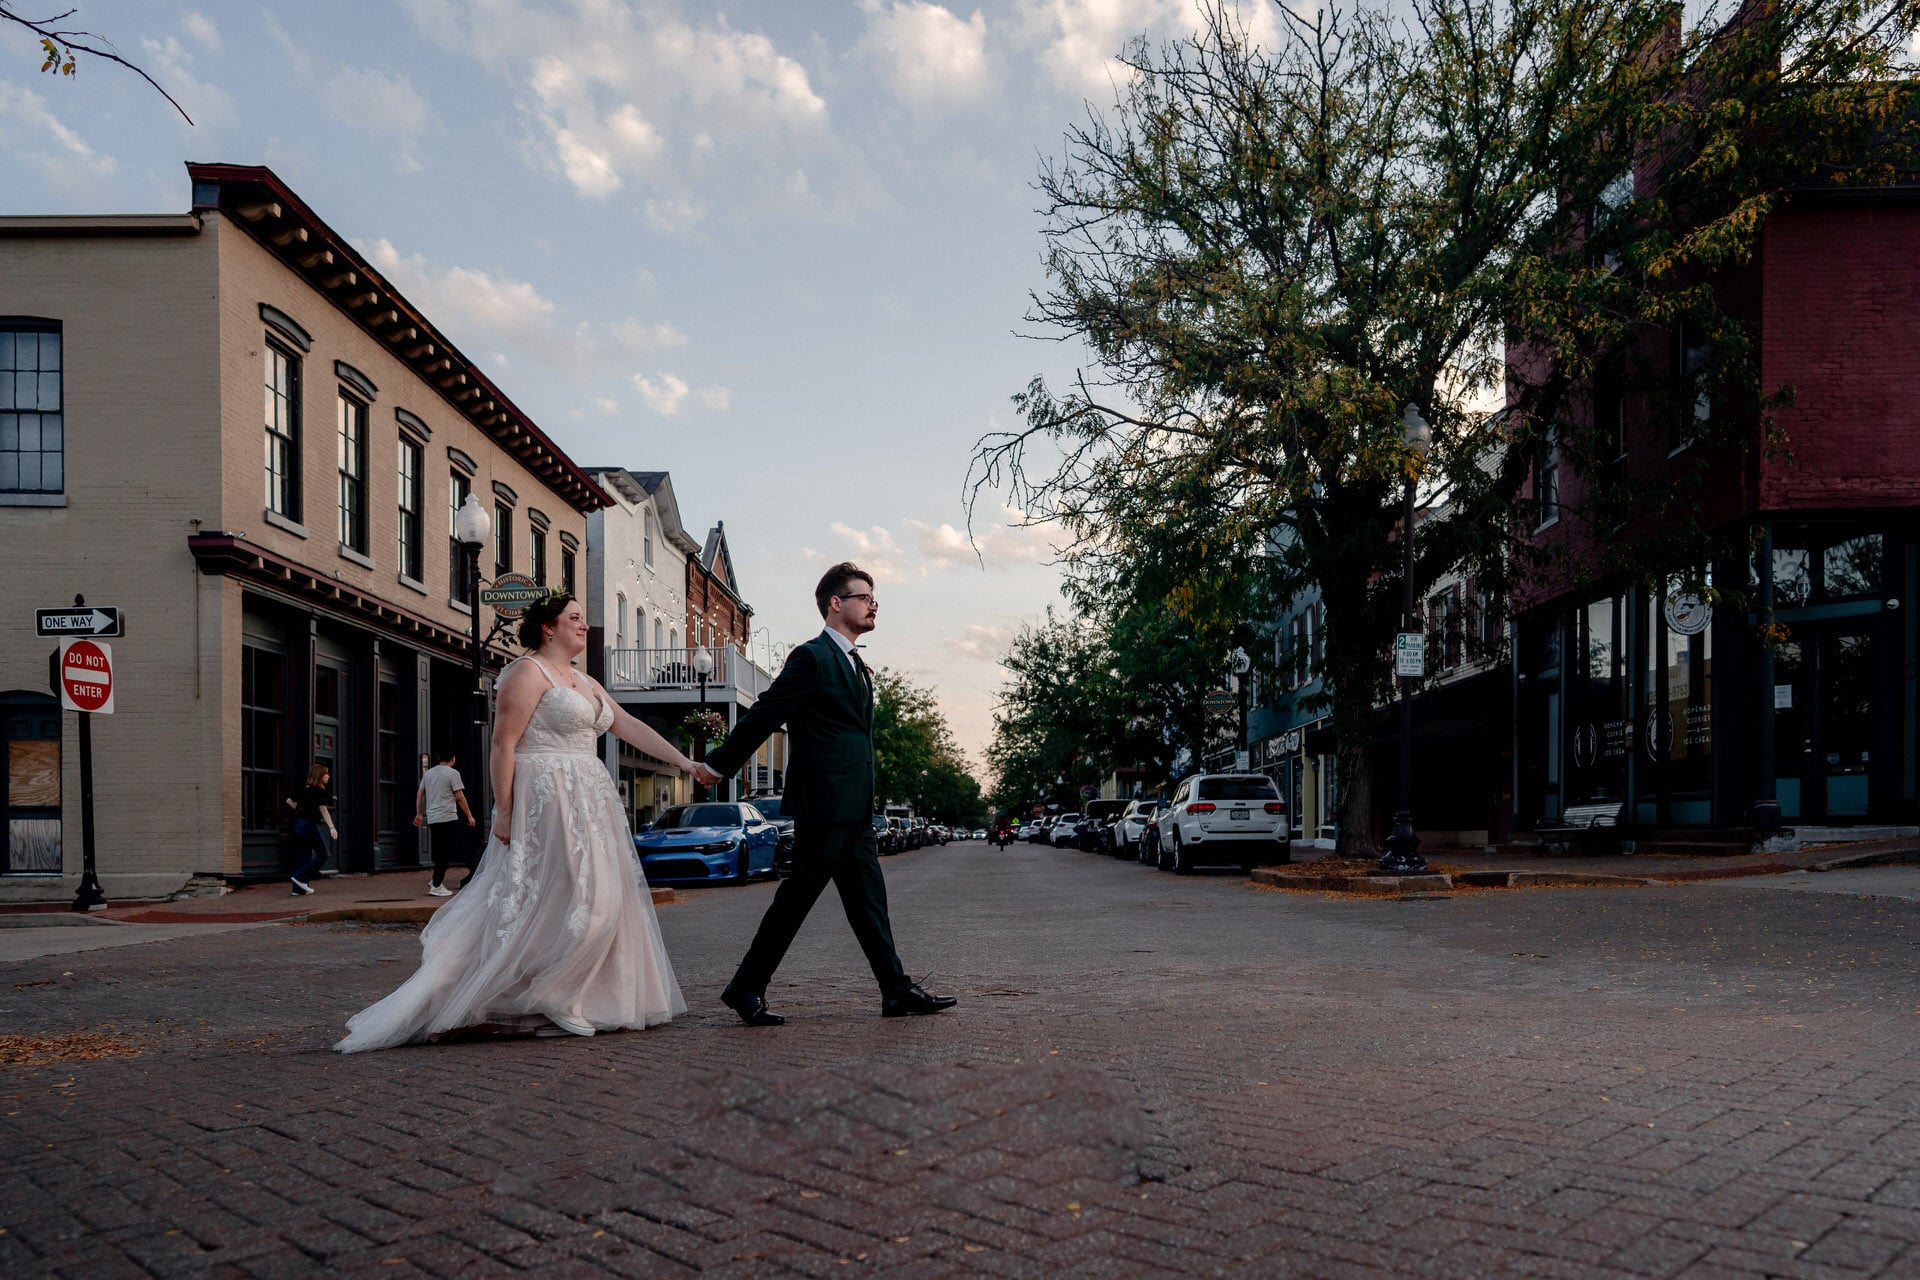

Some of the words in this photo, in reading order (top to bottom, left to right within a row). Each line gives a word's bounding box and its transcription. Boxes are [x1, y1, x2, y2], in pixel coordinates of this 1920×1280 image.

[498, 576, 528, 585] HISTORIC
[484, 590, 543, 600] DOWNTOWN
[504, 608, 523, 616] CHAR
[45, 617, 67, 628] ONE
[70, 616, 93, 627] WAY
[1399, 637, 1405, 647] 2
[69, 652, 82, 665] DO
[86, 655, 104, 668] NOT
[73, 684, 102, 698] ENTER
[1683, 704, 1711, 715] HOMEMAD
